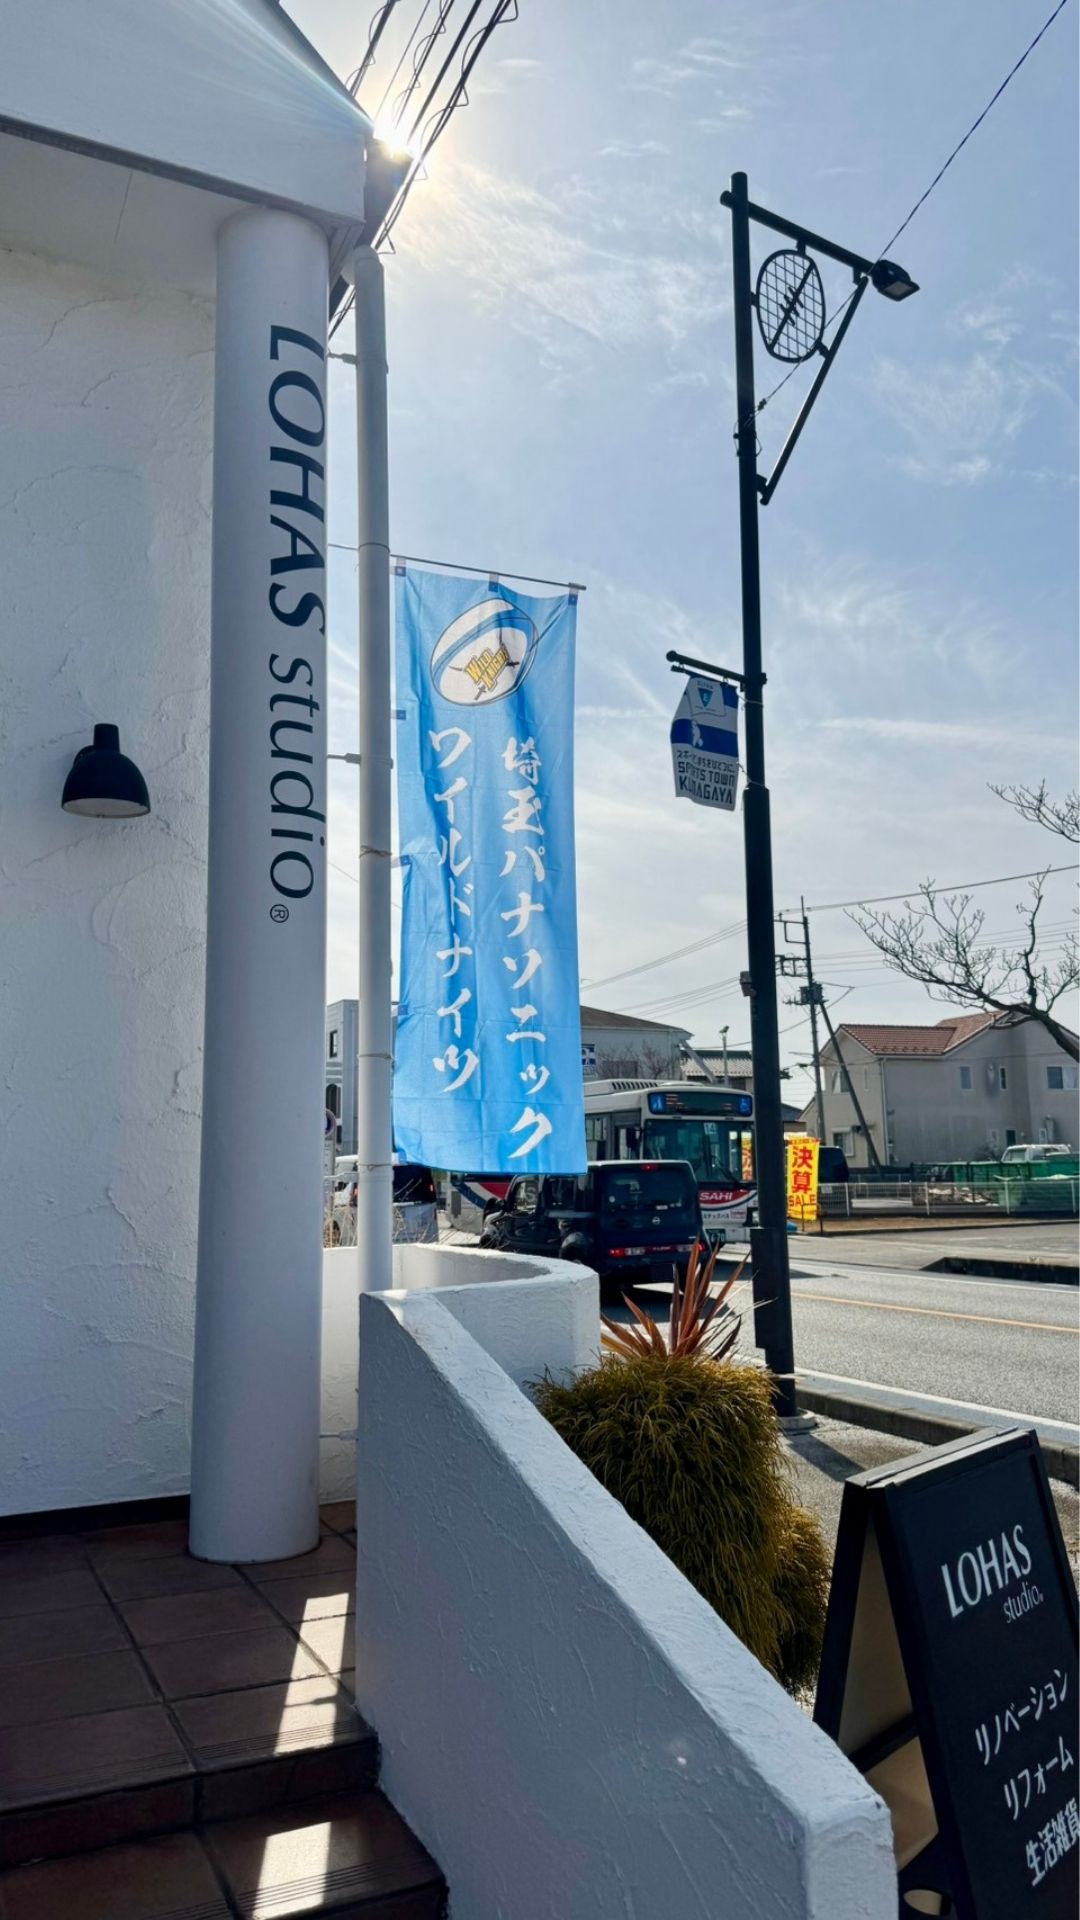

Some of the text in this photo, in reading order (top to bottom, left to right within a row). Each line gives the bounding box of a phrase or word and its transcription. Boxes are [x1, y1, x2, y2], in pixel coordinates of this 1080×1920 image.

[268, 324, 326, 636] LOHAS
[678, 761, 706, 782] SPRTS
[429, 726, 479, 1093] ワイルドナイツ
[500, 737, 552, 1158] 埼玉パナソニック
[699, 1192, 733, 1200] SAHI
[788, 1194, 816, 1208] SALE
[791, 1146, 816, 1195] 決算
[941, 1524, 1032, 1618] LOHAS
[975, 1668, 1068, 1766] リノベーション
[1004, 1735, 1074, 1821] リフォーム
[1025, 1797, 1080, 1887] 生活雑貨
